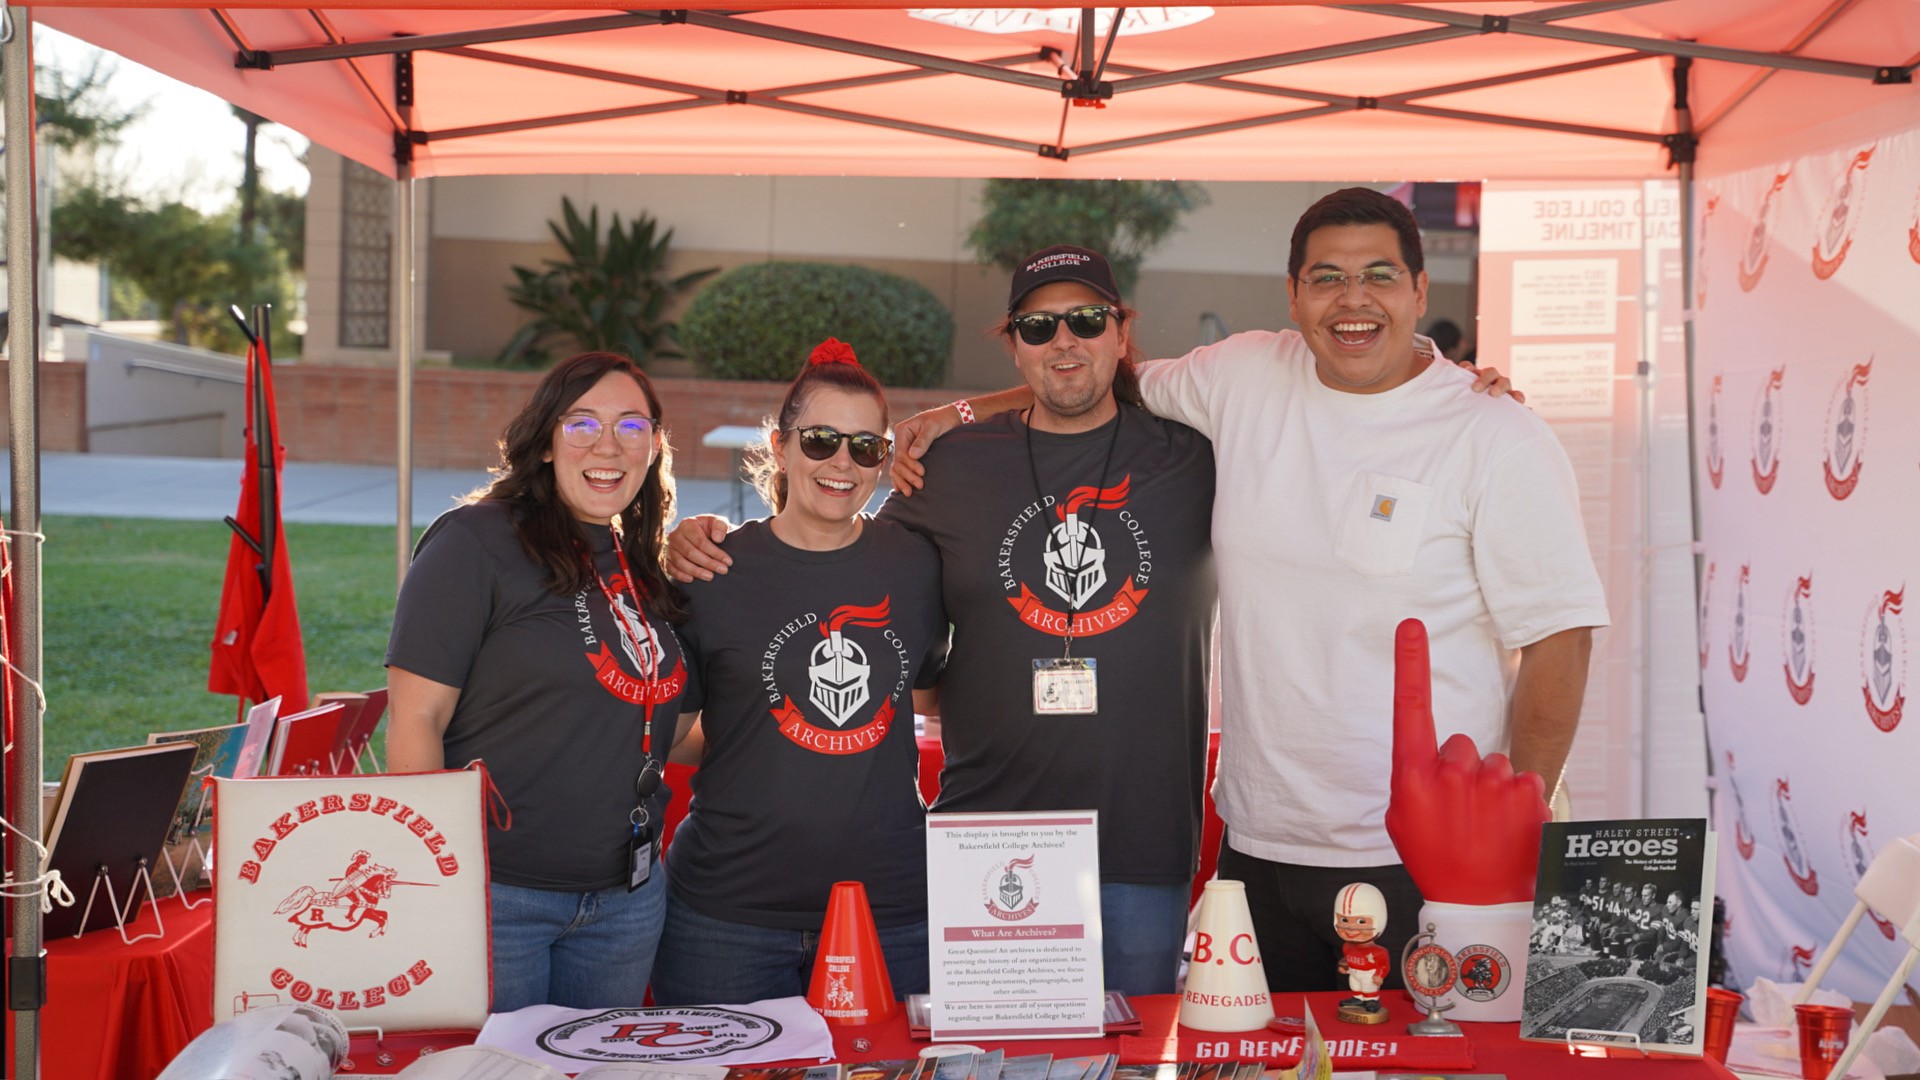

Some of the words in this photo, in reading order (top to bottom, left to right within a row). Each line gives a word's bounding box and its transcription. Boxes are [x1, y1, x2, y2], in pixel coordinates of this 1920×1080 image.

[1026, 253, 1091, 272] BAKERSFIELD
[1033, 260, 1081, 273] COLLEGE
[1119, 510, 1152, 584] COLLEGE
[1027, 601, 1130, 634] ARCHIVES
[762, 612, 818, 704] BAKERSFIELD
[883, 629, 910, 702] COLLEGE
[786, 720, 887, 751] ARCHIVES
[238, 792, 460, 885] BAKERSFIELD
[945, 831, 962, 839] This
[963, 831, 990, 840] display
[1000, 830, 1029, 839] brought
[1040, 831, 1054, 839] you
[1055, 829, 1064, 839] by
[1595, 830, 1632, 838] HALEY
[1636, 828, 1680, 837] STREET
[1002, 842, 1030, 851] College
[1031, 841, 1065, 849] Archives!
[1564, 834, 1679, 858] Heroes
[310, 907, 324, 922] R
[992, 907, 1033, 920] ARCHIVES
[971, 929, 995, 938] What
[997, 929, 1013, 937] Are
[1015, 928, 1057, 937] Archives?
[966, 948, 997, 956] Question!
[1193, 932, 1261, 966] B.C.
[943, 958, 976, 967] preserving
[988, 957, 1010, 965] history
[1028, 956, 1069, 965] organization.
[965, 967, 1000, 975] Bakersfield
[1002, 967, 1026, 976] College
[1027, 966, 1056, 974] Archives,
[270, 959, 433, 1011] COLLEGE
[957, 979, 990, 987] preserving
[991, 977, 1028, 986] documents,
[1029, 976, 1070, 985] photographs,
[1053, 1001, 1086, 1009] questions
[1185, 990, 1268, 1008] RENEGADES
[643, 1010, 672, 1018] WILL
[676, 1009, 725, 1018] ALWAYS
[948, 1014, 981, 1022] regarding
[1034, 1012, 1060, 1021] College
[1061, 1011, 1085, 1020] legacy!
[1196, 1040, 1230, 1059] GO
[1239, 1035, 1398, 1059] RENEADES!
